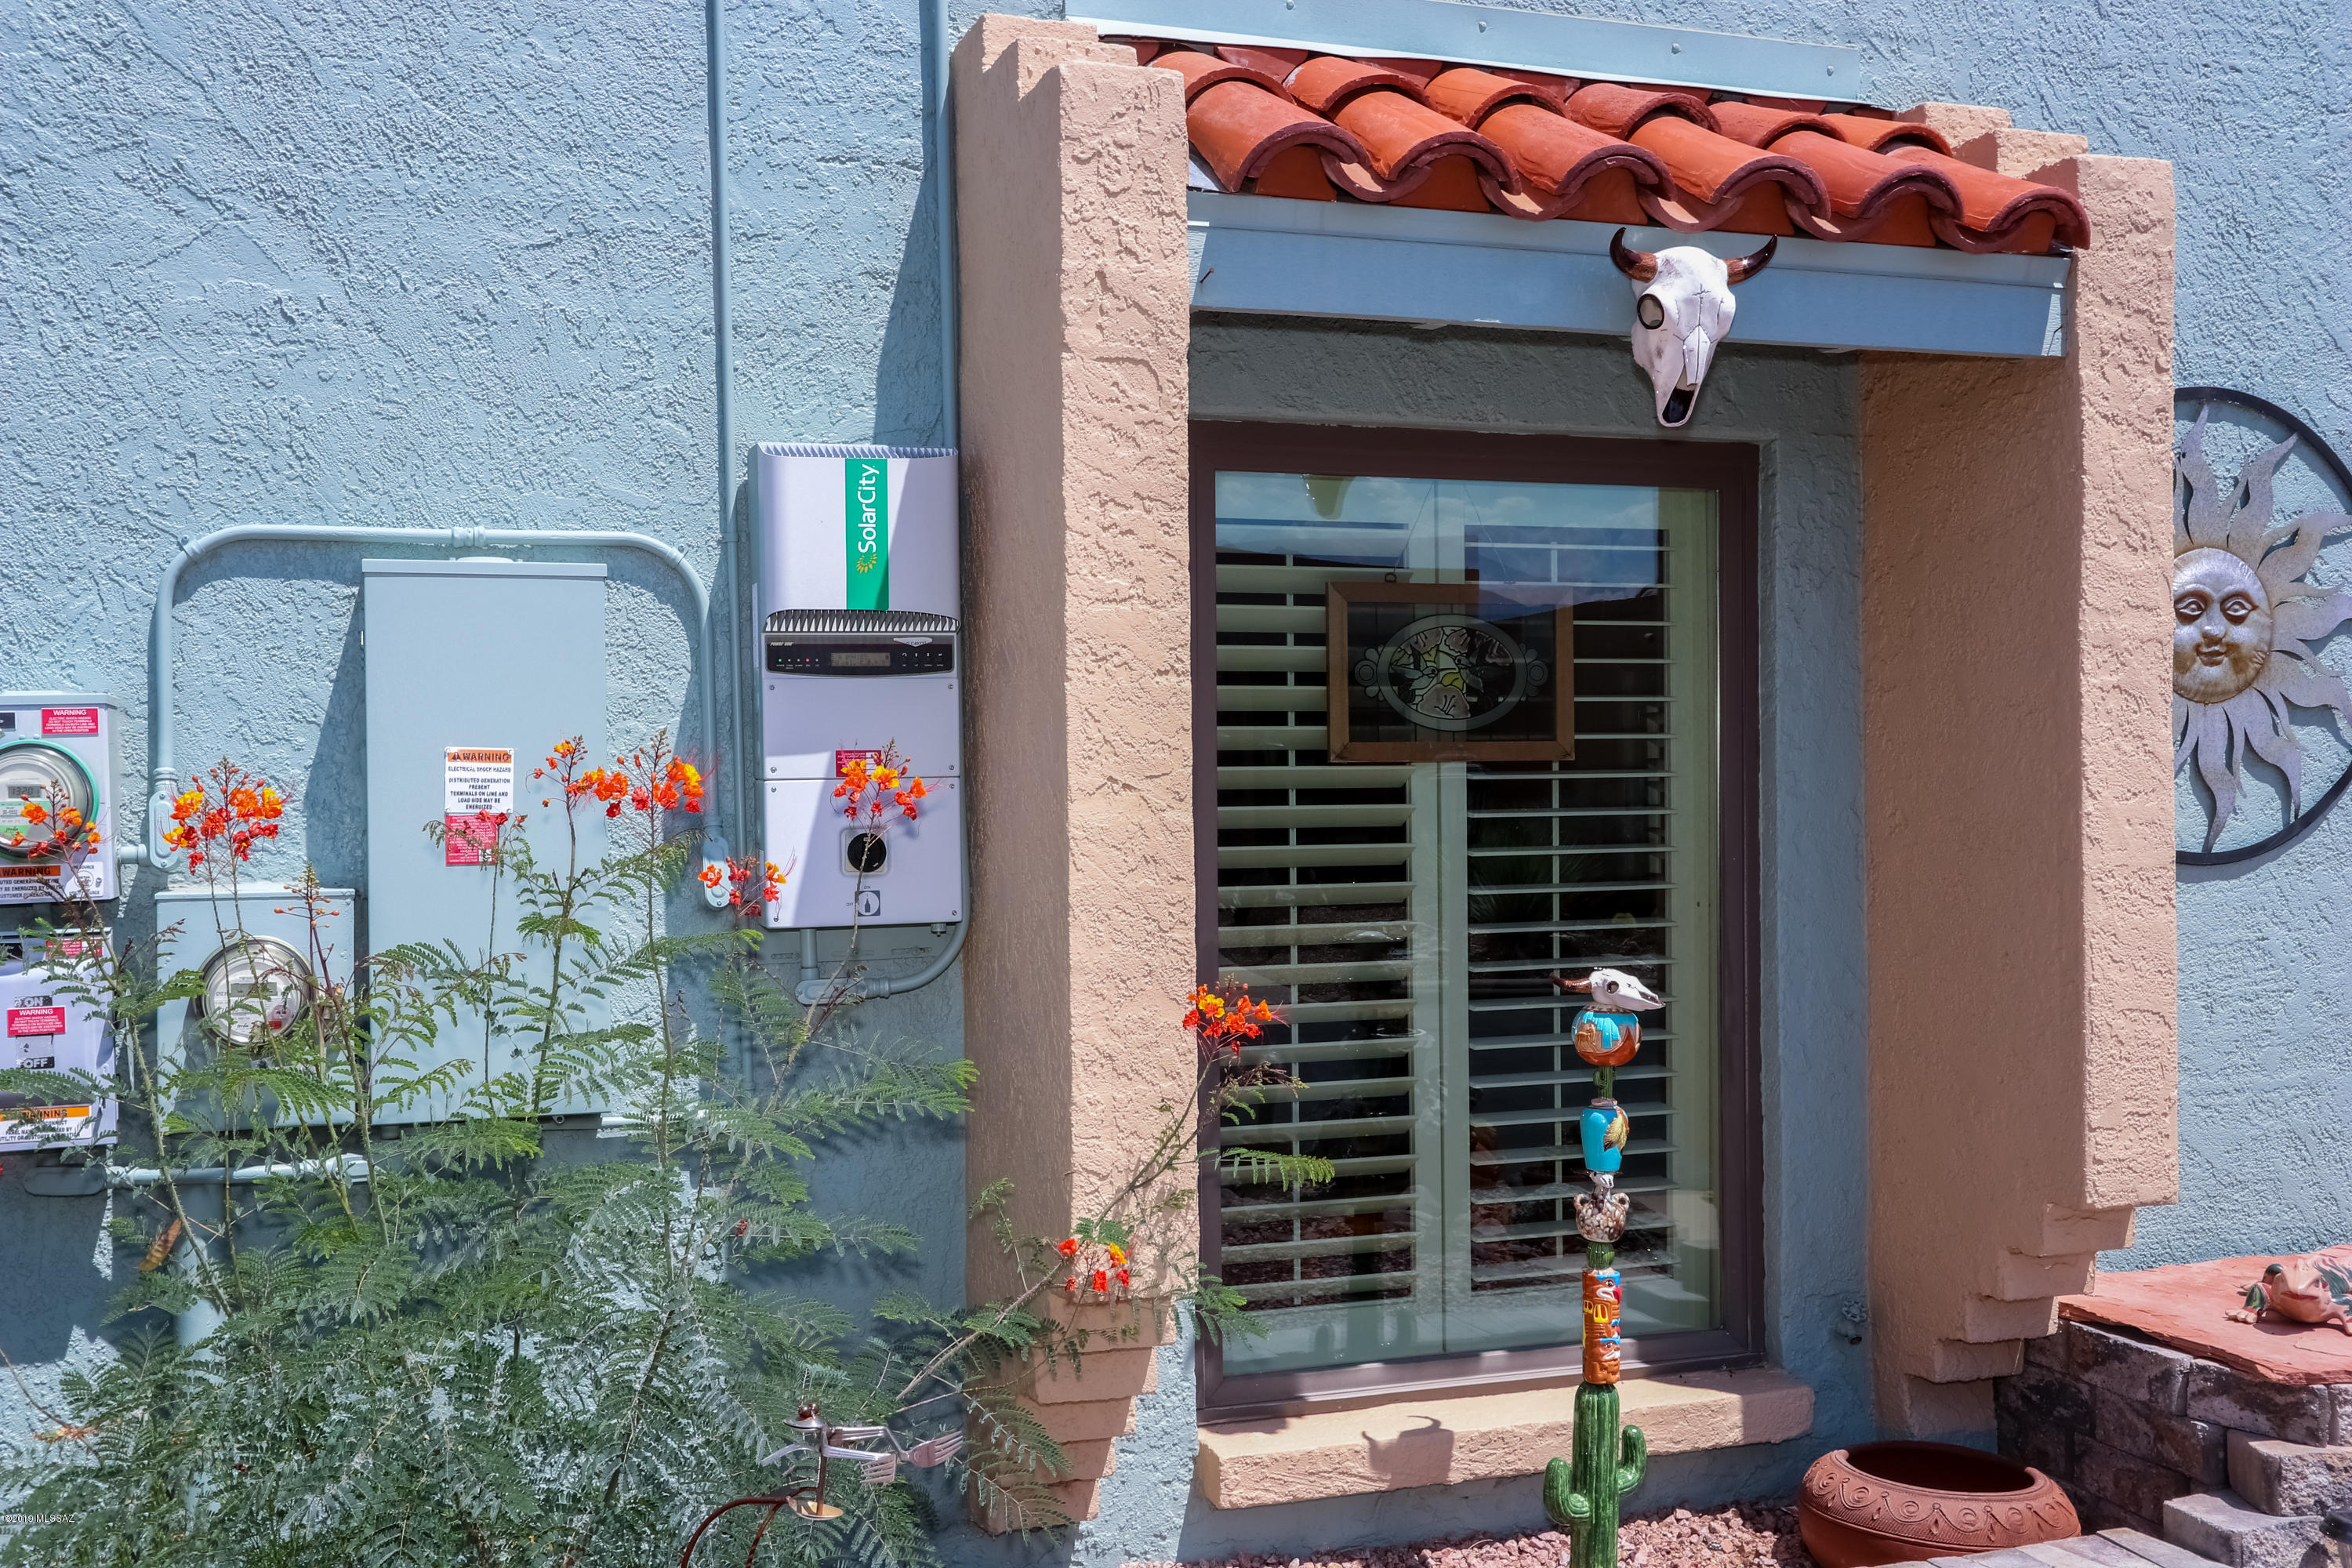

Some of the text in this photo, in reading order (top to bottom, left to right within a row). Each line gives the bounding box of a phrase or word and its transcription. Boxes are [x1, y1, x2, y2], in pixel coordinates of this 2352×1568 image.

[858, 464, 880, 553] SolarCity
[463, 753, 509, 761] WARNING
[2, 867, 51, 877] WARNING
[25, 996, 43, 1007] ON
[24, 1058, 48, 1068] OFF
